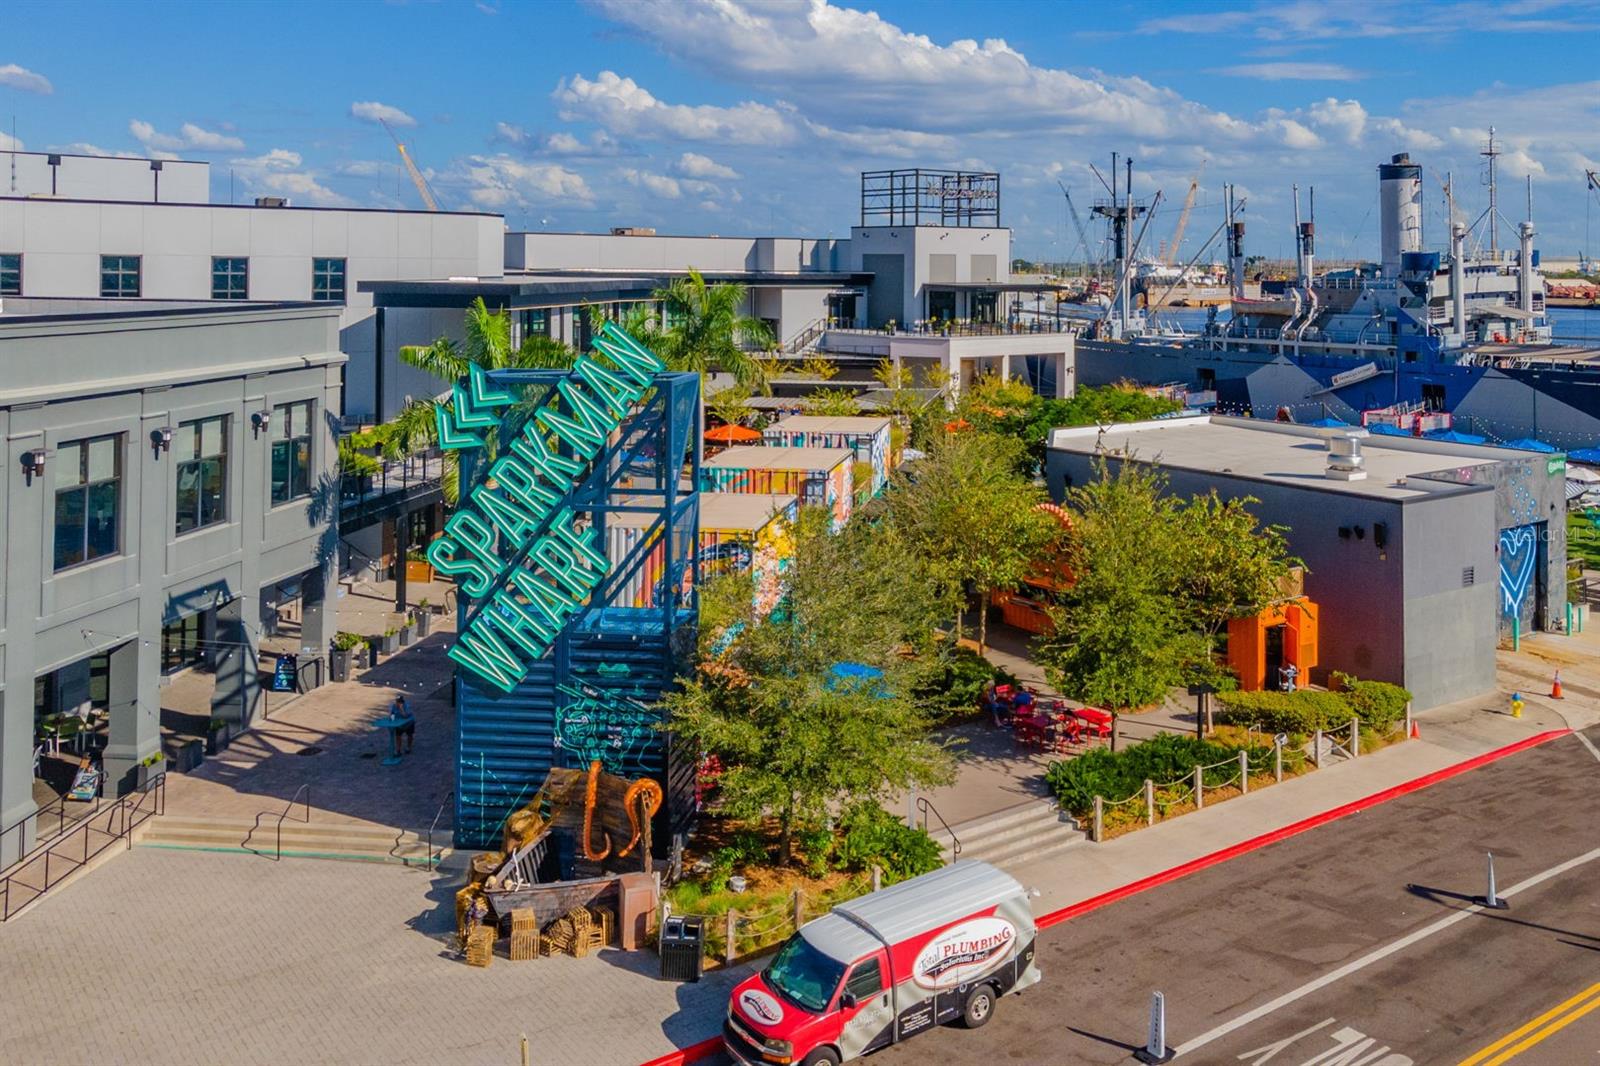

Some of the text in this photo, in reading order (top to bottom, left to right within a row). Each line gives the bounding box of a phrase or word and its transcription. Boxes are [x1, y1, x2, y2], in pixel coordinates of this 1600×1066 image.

[426, 320, 666, 599] SPARKMAN
[447, 506, 612, 693] WHARF
[943, 926, 1016, 957] PLUMBING
